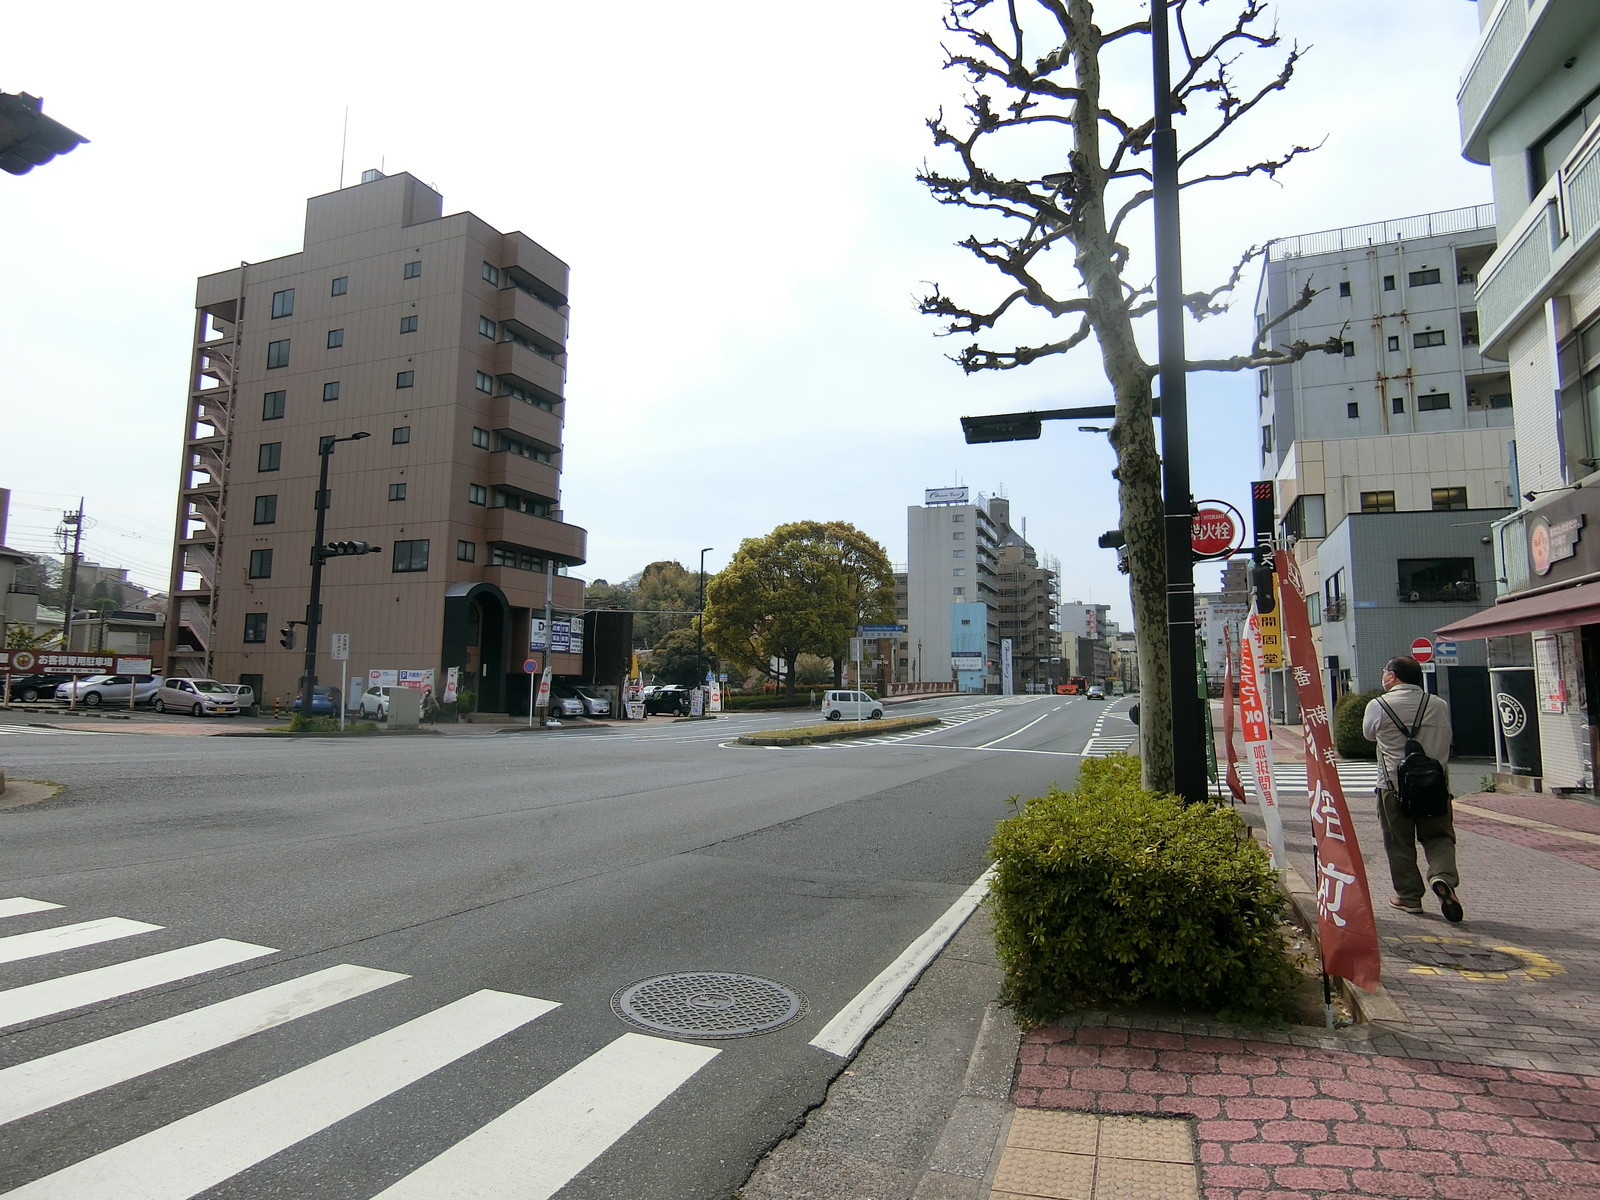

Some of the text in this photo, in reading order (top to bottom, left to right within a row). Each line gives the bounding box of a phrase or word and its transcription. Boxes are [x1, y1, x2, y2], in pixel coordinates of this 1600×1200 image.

[38, 654, 113, 667] お客様専用駐車場
